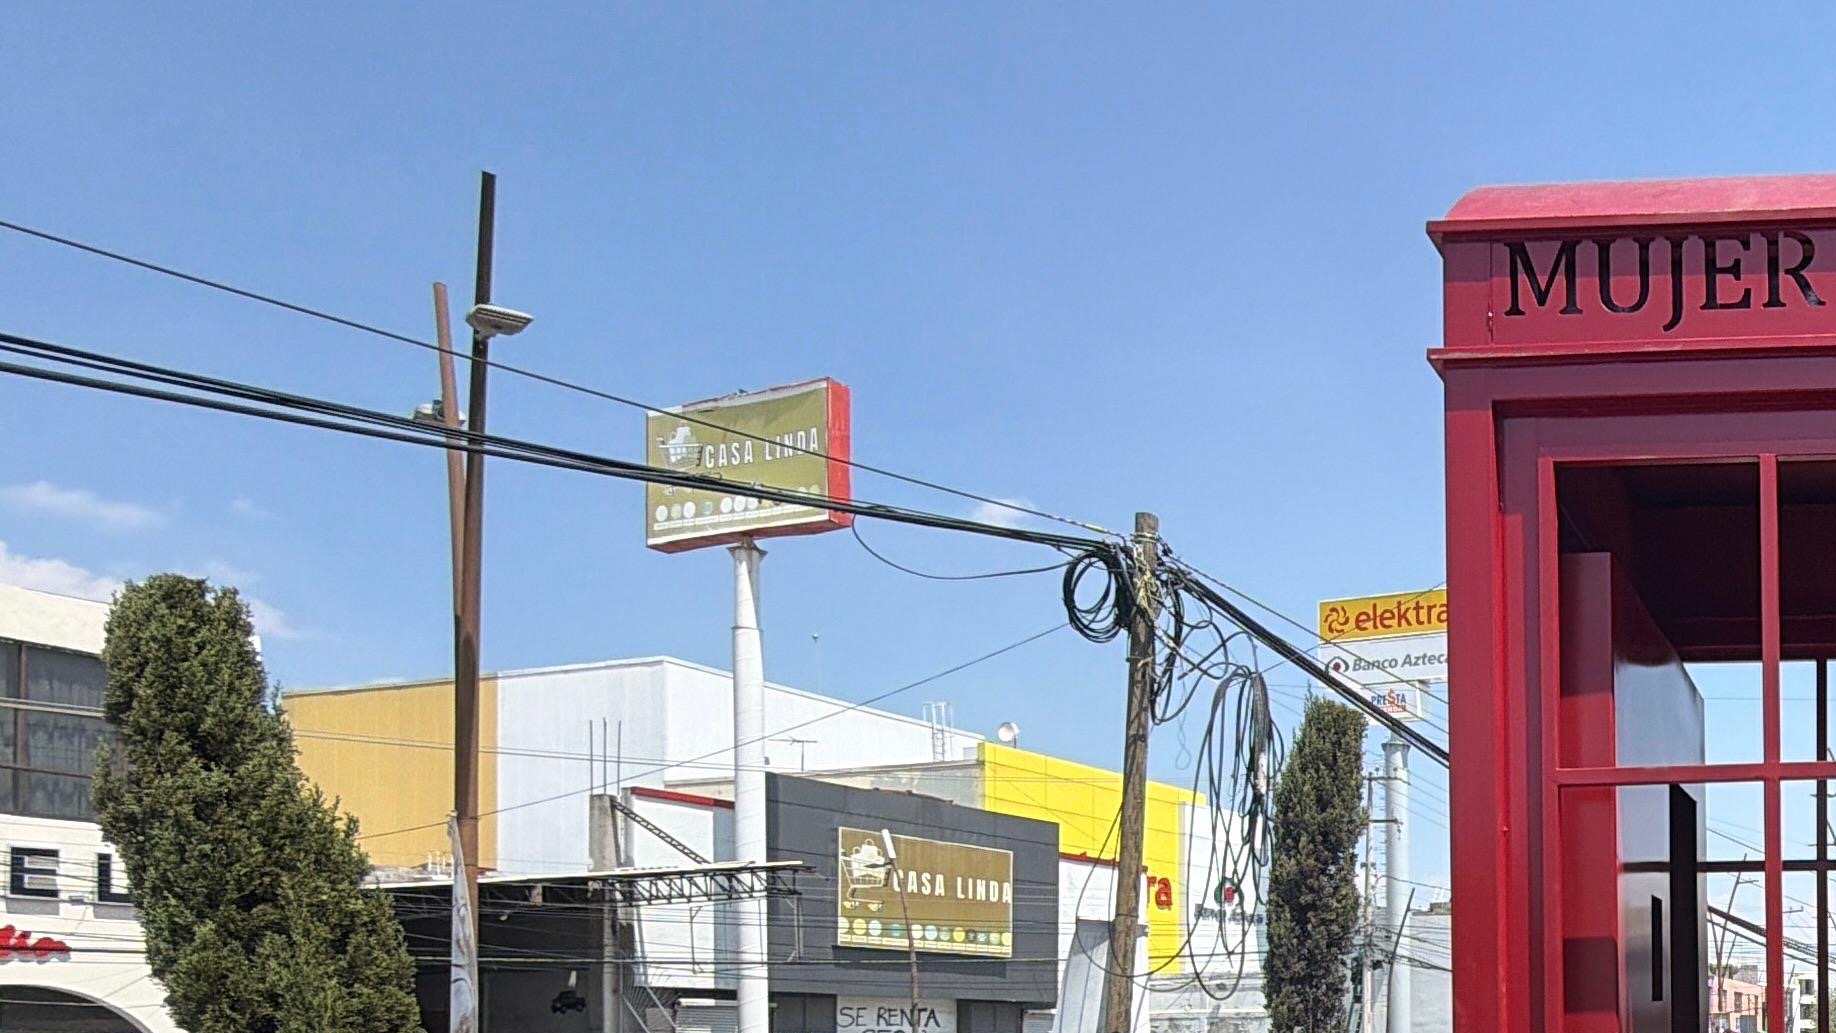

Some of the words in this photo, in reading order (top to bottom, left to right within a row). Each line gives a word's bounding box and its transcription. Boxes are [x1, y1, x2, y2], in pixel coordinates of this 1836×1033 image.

[1503, 231, 1827, 333] MUJER
[705, 440, 754, 469] CASA
[765, 427, 819, 461] LINDA
[1355, 601, 1447, 631] elektra
[1352, 657, 1399, 672] Banco
[892, 869, 946, 897] CASA
[957, 876, 1012, 905] LINDA
[837, 1006, 868, 1028] SE
[876, 1006, 941, 1028] RENTA
